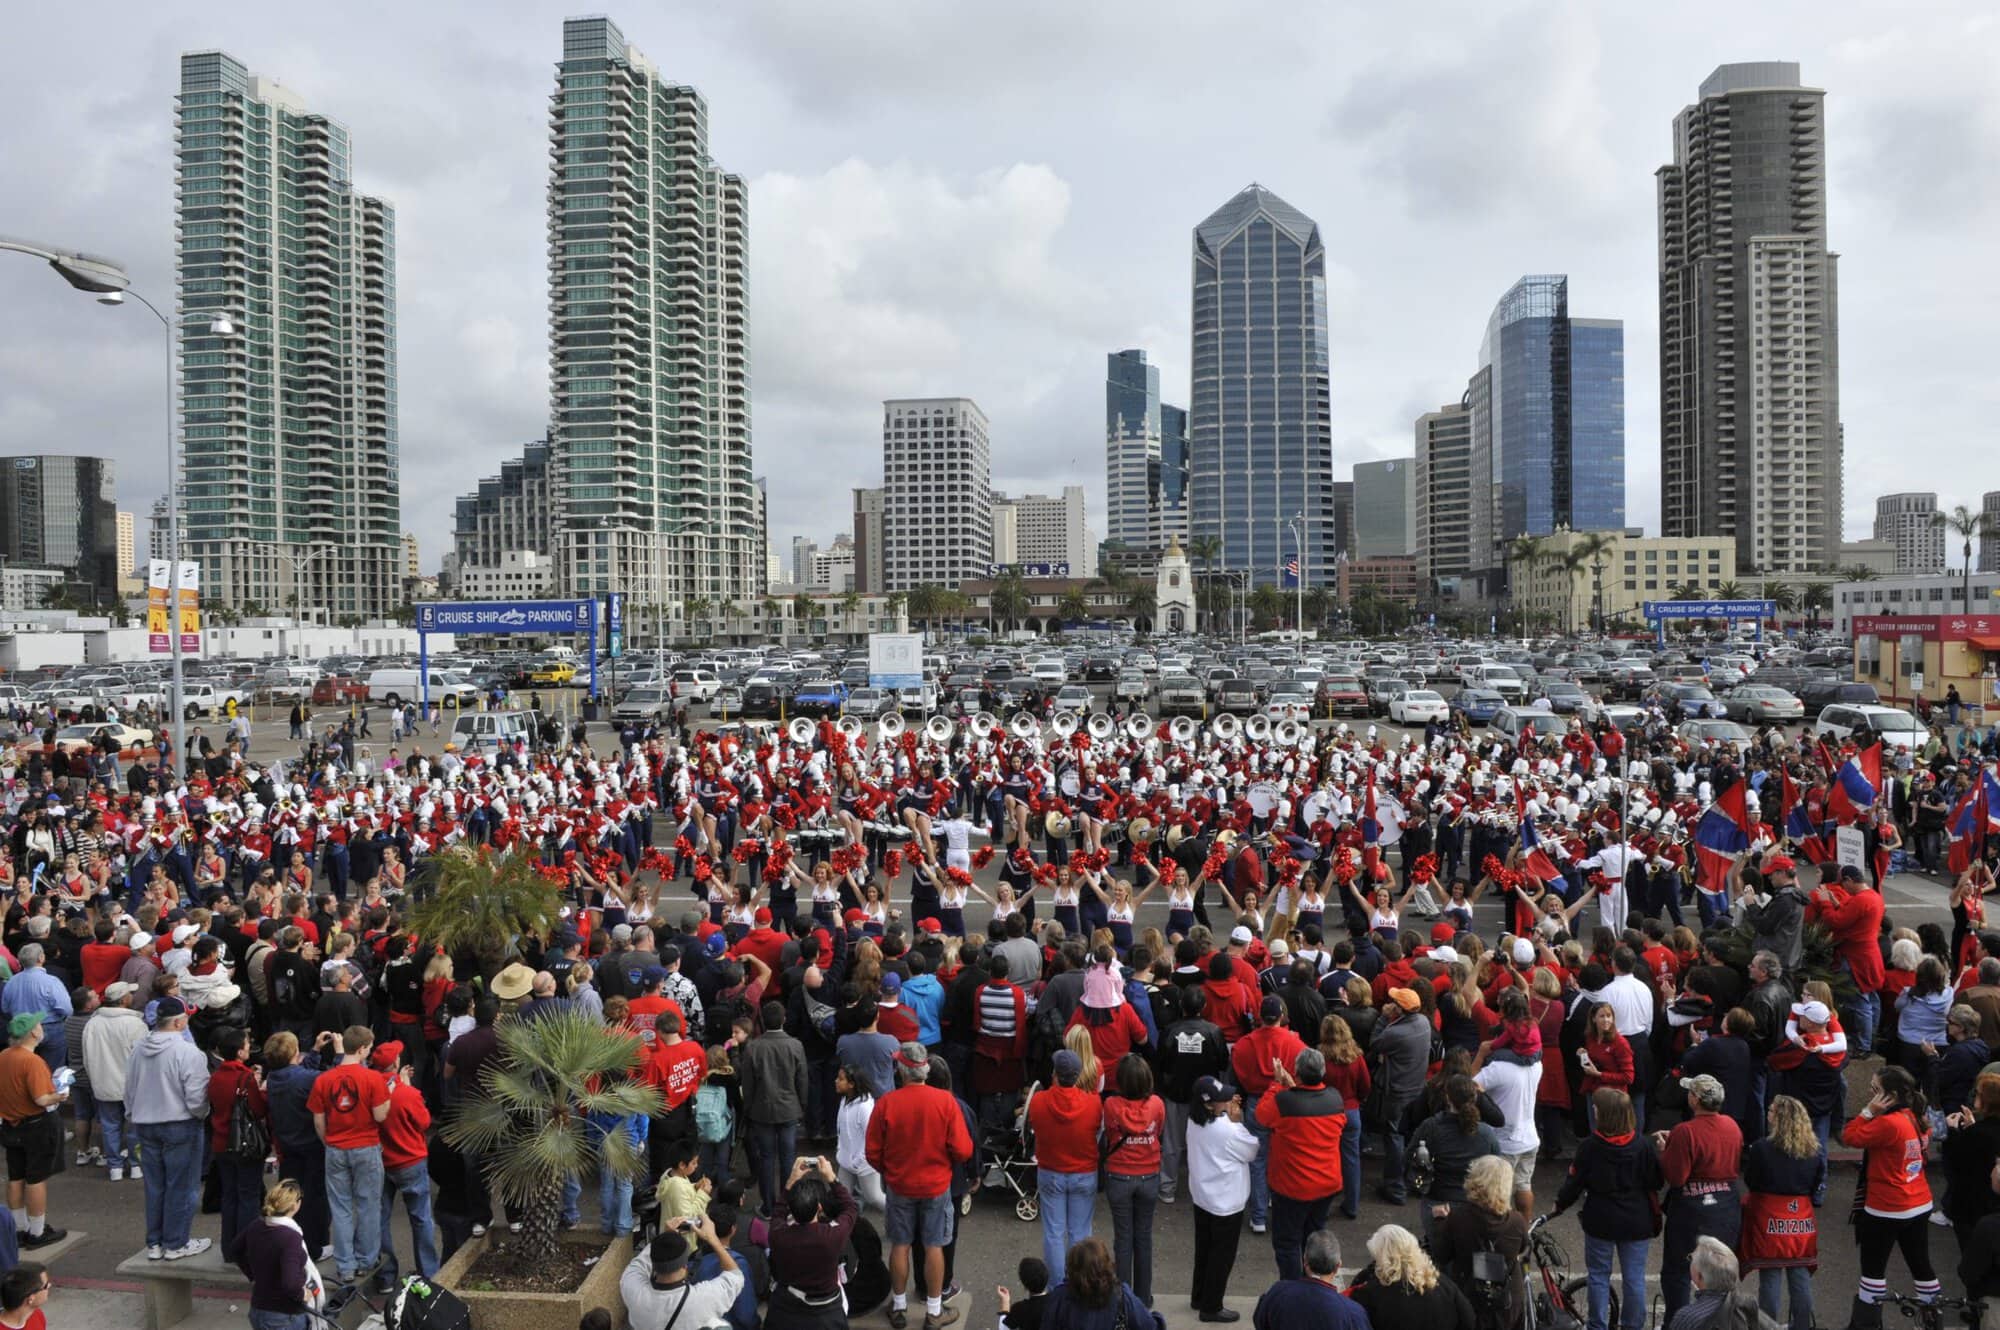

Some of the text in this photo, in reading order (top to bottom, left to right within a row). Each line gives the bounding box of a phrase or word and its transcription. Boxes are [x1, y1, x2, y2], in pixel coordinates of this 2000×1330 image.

[1049, 564, 1067, 575] Fe
[578, 605, 588, 619] 5
[612, 595, 619, 618] 5
[1687, 605, 1706, 613] SHIP
[423, 607, 433, 622] 5
[437, 612, 474, 624] CRUISE
[476, 611, 499, 624] SHIP
[528, 610, 573, 622] PARKING
[612, 636, 619, 654] P
